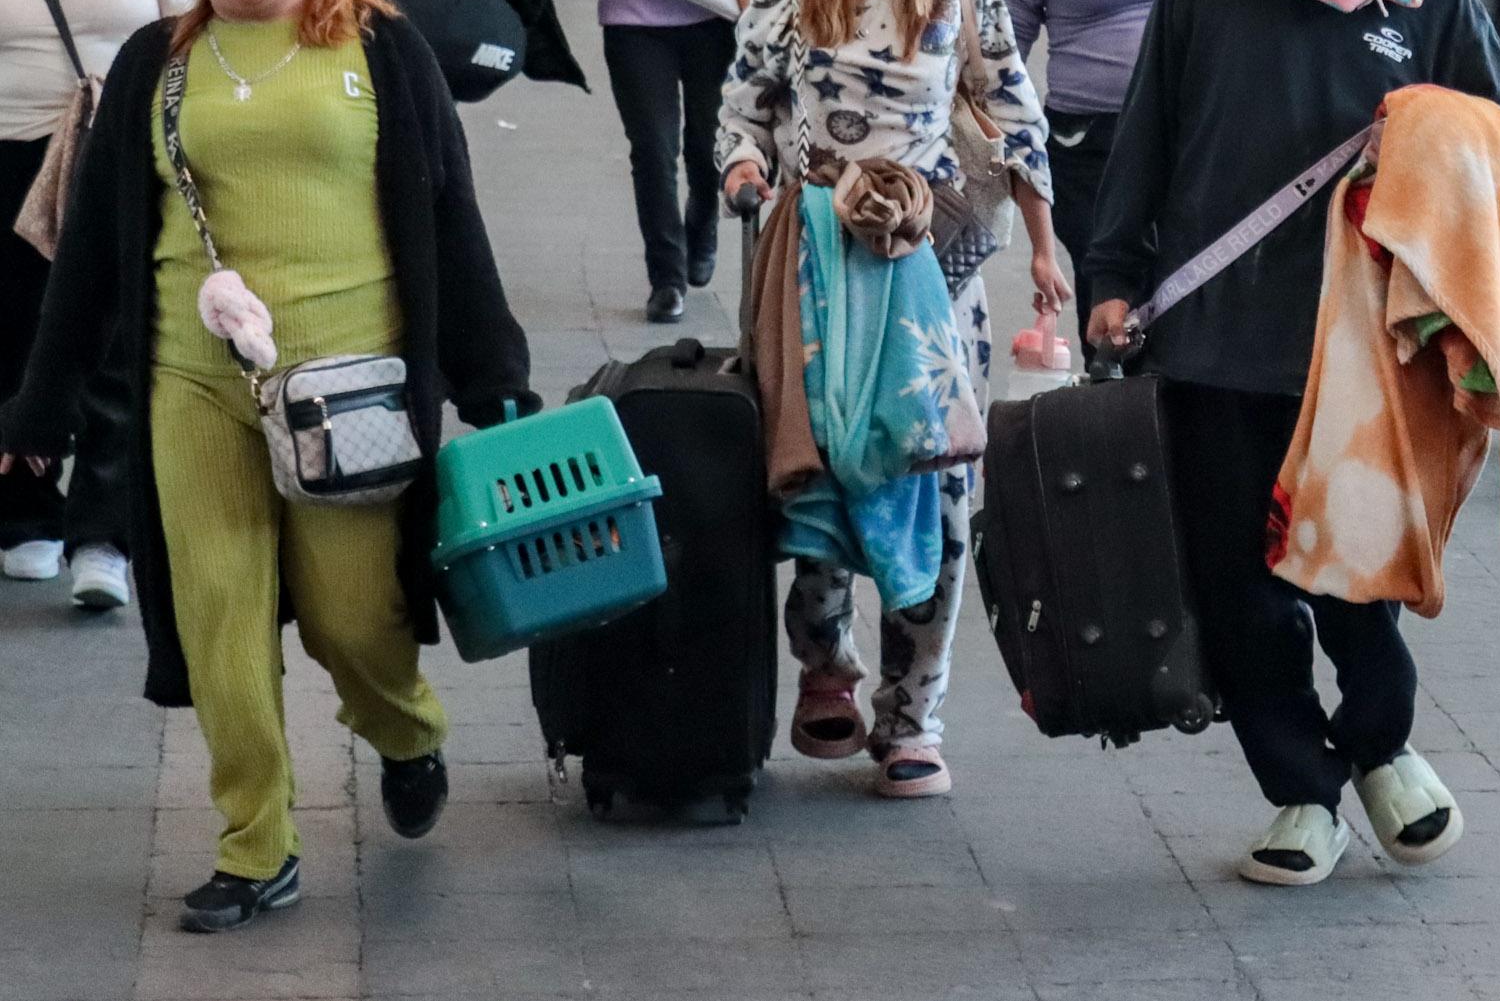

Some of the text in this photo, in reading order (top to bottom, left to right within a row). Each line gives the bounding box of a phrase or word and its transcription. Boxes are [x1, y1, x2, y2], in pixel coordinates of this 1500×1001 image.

[470, 43, 515, 72] NIKE
[1363, 32, 1412, 59] COOPER
[1369, 41, 1404, 63] TIRES
[343, 71, 360, 97] C
